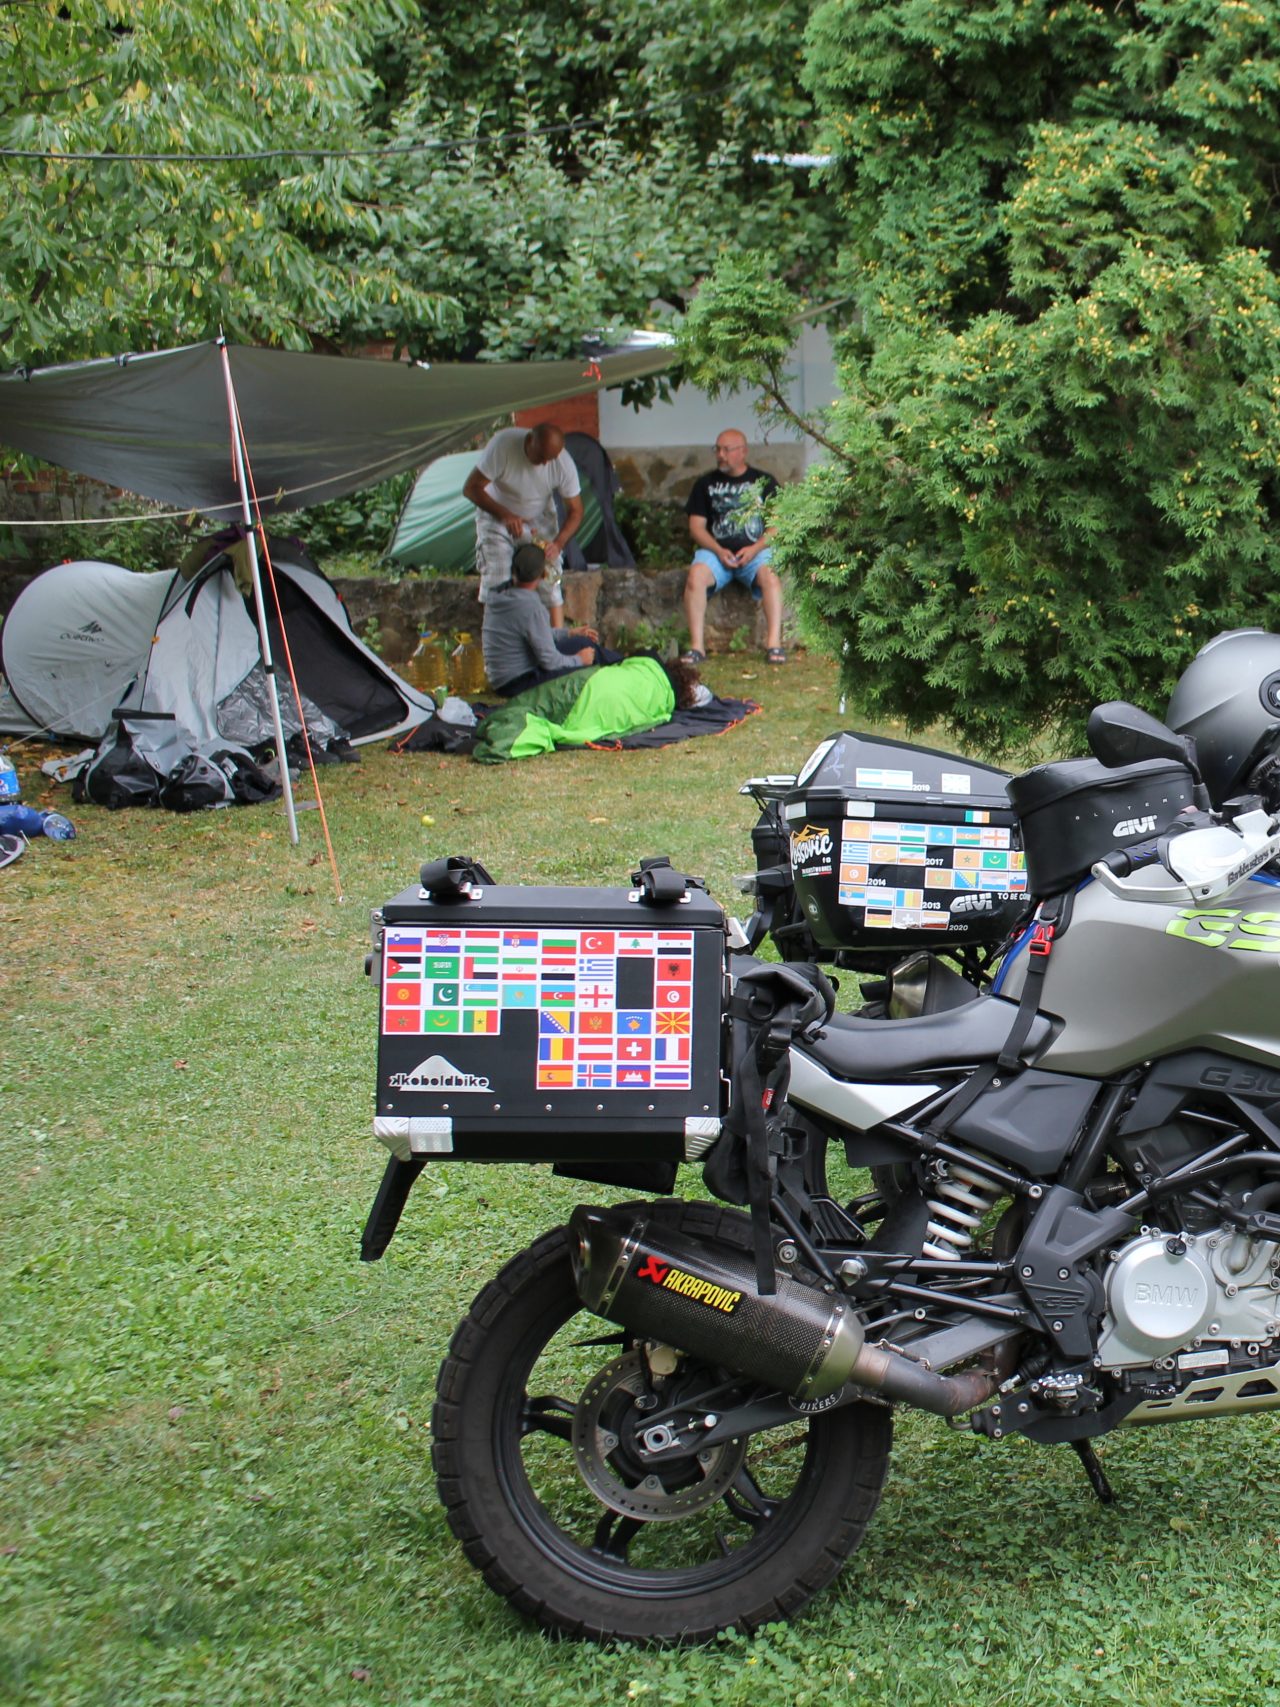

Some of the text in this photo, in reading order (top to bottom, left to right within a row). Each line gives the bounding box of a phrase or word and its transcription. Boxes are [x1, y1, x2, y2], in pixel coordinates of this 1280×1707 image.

[1113, 815, 1158, 838] GIVI
[868, 878, 887, 887] 2014
[950, 892, 993, 914] GIVI
[997, 892, 1009, 901] TO
[1010, 892, 1018, 901] BE
[922, 902, 941, 910] 2013
[949, 924, 968, 932] 2020
[1135, 1282, 1199, 1308] BMW
[800, 1393, 837, 1411] BIKERS
